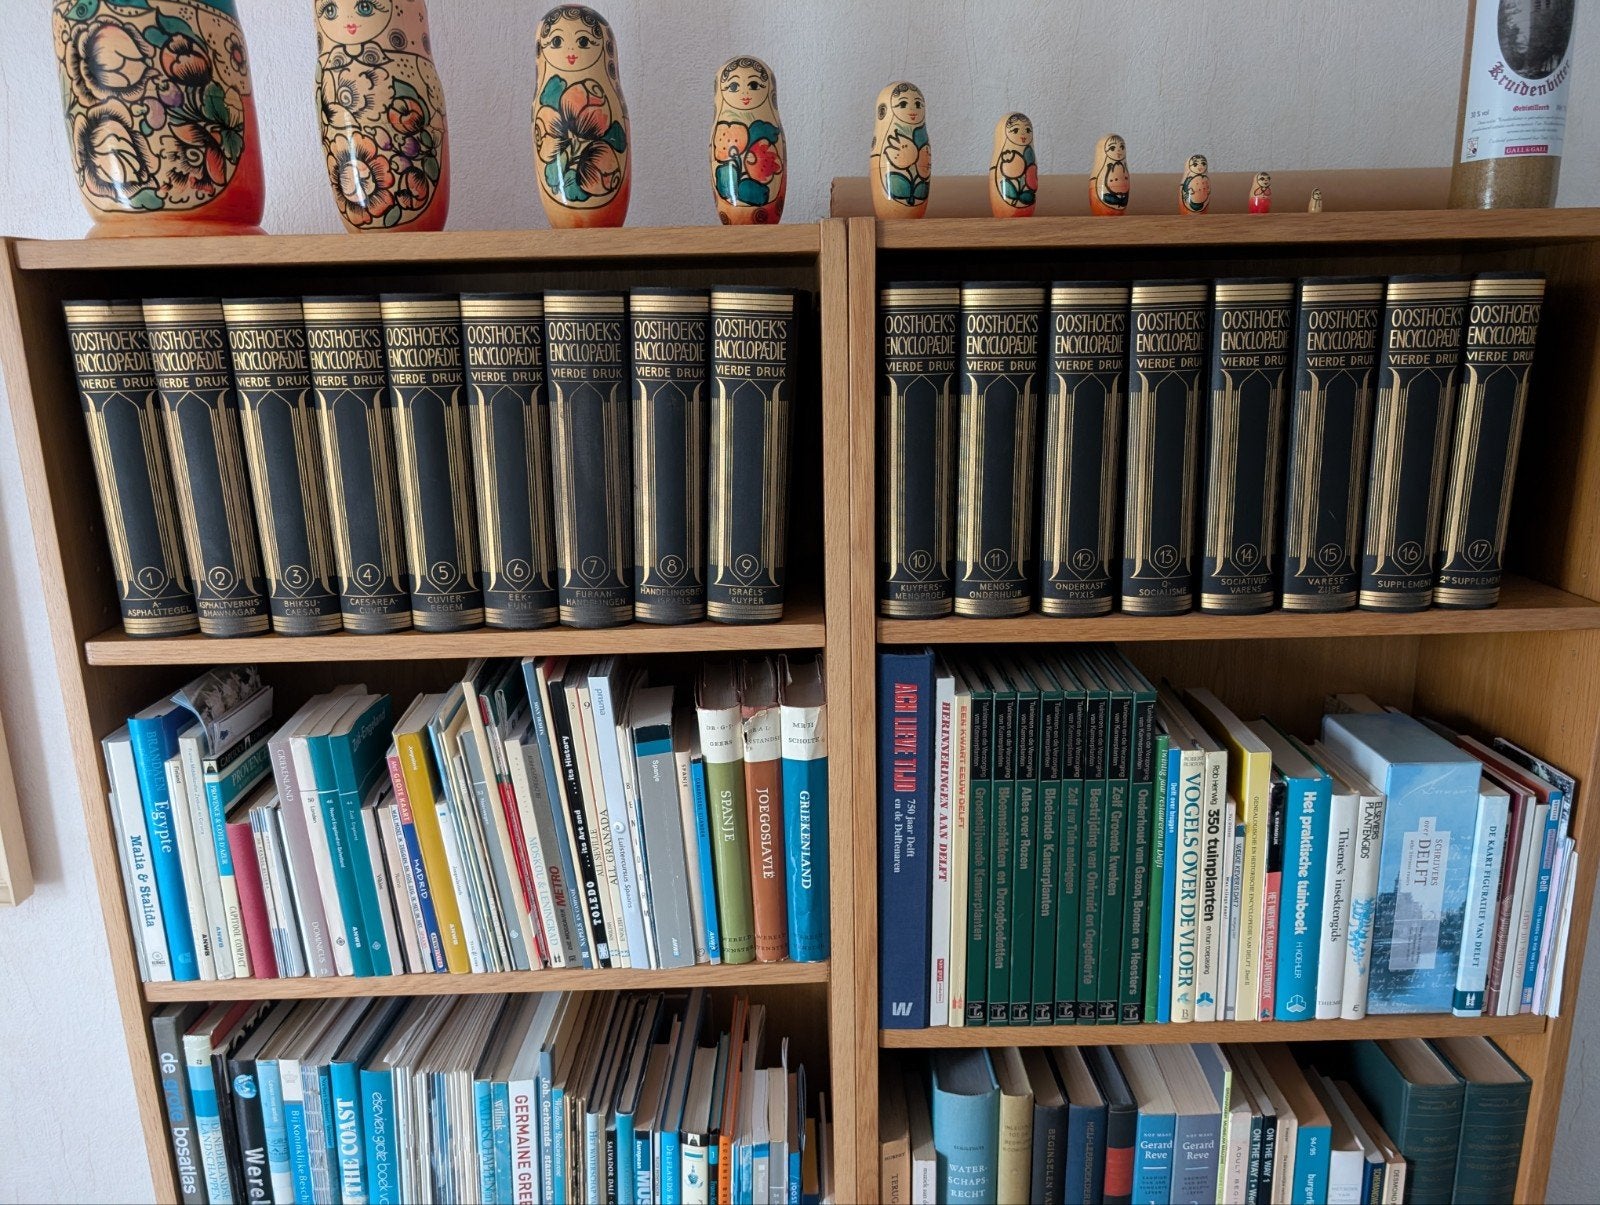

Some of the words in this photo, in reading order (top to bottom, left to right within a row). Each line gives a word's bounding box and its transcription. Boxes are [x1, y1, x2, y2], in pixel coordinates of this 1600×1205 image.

[1488, 60, 1570, 97] Kruidenbitter
[967, 314, 1038, 333] OOSTHOEK'S
[1471, 305, 1540, 323] OOSTHOEK'S
[230, 329, 304, 349] OOSTHOEK'S
[468, 325, 541, 345] OOSTHOEK'S
[715, 319, 786, 339] OOSTHOEK'S
[967, 361, 1004, 371] VIERDE
[1010, 360, 1037, 370] DRUK
[1467, 351, 1507, 361] VIERDE
[238, 377, 271, 388] VIERDE
[277, 375, 310, 386] DRUK
[472, 371, 507, 381] VIERDE
[513, 371, 543, 381] DRUK
[715, 365, 751, 375] VIERDE
[756, 367, 786, 377] DRUK
[1473, 544, 1488, 557] 17
[729, 588, 766, 596] ISRAELS-
[980, 583, 1014, 591] MENGS-
[1069, 590, 1095, 599] PYXIS
[1138, 587, 1188, 596] SOCIALISME
[286, 607, 320, 616] CAESAR
[732, 597, 764, 605] KUYPER
[595, 689, 607, 716] prisma
[894, 684, 918, 712] ACH
[894, 717, 917, 754] LIEVE
[959, 730, 967, 764] KWART
[147, 731, 164, 791] BRANDAEN
[561, 736, 573, 767] History
[938, 701, 951, 809] HERINNERINGEN
[277, 749, 293, 802] GRIEKENLAND
[894, 759, 917, 792] TIJD
[958, 766, 967, 795] EEUW
[1212, 765, 1221, 777] Rob
[394, 774, 405, 796] GROTE
[1111, 787, 1123, 808] Zelf
[1210, 780, 1220, 805] Herwig
[399, 798, 411, 821] KAART
[894, 799, 901, 808] en
[906, 799, 915, 813] 750
[1021, 787, 1032, 812] Alles
[1183, 773, 1201, 847] VOGELS
[1303, 792, 1317, 813] Het
[152, 800, 172, 853] Egypte
[574, 810, 582, 824] and
[721, 790, 735, 842] SPANJE
[894, 810, 903, 821] de
[904, 816, 915, 834] jaar
[938, 812, 949, 840] AAN
[958, 798, 966, 829] DELFT
[1021, 815, 1030, 837] over
[1043, 789, 1056, 840] Bloeiende
[1135, 789, 1148, 844] Onderhoud
[1208, 809, 1220, 834] 350
[1371, 802, 1382, 839] ELSEVIERS
[577, 826, 586, 840] Art
[599, 809, 615, 862] GRANADA
[756, 788, 775, 879] JOEGOSLAVIË
[800, 791, 812, 889] GRIEKENLAND
[1110, 811, 1122, 852] Groente
[1361, 802, 1374, 859] PLANTENGIDS
[1423, 821, 1431, 836] over
[1489, 826, 1497, 837] DE
[590, 828, 601, 860] SEVILLE
[893, 824, 903, 873] Delftenaren
[906, 836, 916, 857] Delft
[1020, 839, 1030, 869] Rozen
[1135, 847, 1145, 863] van
[1298, 816, 1315, 877] praktische
[1336, 828, 1350, 874] Thieme's
[1485, 840, 1496, 867] KAART
[607, 865, 618, 885] ALL
[618, 837, 629, 882] Luistercursus
[624, 885, 633, 909] Spaans
[938, 843, 948, 882] DELFT
[1107, 856, 1119, 896] kweken
[1180, 851, 1198, 901] OVER
[1414, 839, 1431, 886] DELFT
[1430, 839, 1443, 886] SCHRIJVERS
[131, 835, 146, 870] Malia
[140, 886, 155, 927] Stalida
[413, 859, 427, 899] MADRID
[549, 866, 564, 907] METRO
[1041, 844, 1054, 916] Kamerplanten
[1132, 866, 1145, 898] Gazon,
[1204, 837, 1220, 922] tuinplanten
[586, 881, 601, 925] TOLEDO
[1267, 892, 1276, 904] HET
[1294, 881, 1309, 935] tuinboek
[1478, 870, 1492, 919] FIGURATIEF
[229, 906, 240, 937] CAPITOOL
[1132, 901, 1143, 934] Bomen
[1180, 904, 1195, 927] DE
[1265, 905, 1275, 928] NIEUWE
[1330, 879, 1345, 942] insektengids
[312, 921, 325, 964] DOMINICUS
[1132, 938, 1140, 948] en
[1476, 923, 1485, 939] VAN
[202, 934, 210, 956] ANWB
[234, 938, 246, 967] COMPACT
[1178, 929, 1195, 987] VLOER
[1472, 942, 1483, 967] DELFT
[1129, 953, 1141, 995] Heesters
[1262, 929, 1275, 999] KAMERPLANTENBOEK
[161, 1052, 178, 1074] de
[163, 1078, 185, 1121] grote
[541, 1078, 550, 1097] Joh.
[291, 1110, 301, 1123] Bij
[337, 1098, 357, 1154] COAST
[371, 1092, 387, 1134] elseviers
[494, 1100, 506, 1130] Willink
[542, 1101, 552, 1146] Gerbrands
[479, 1094, 496, 1191] WATERSCHAPPEN
[515, 1095, 531, 1169] GERMAINE
[1140, 1140, 1172, 1150] Gerard
[1182, 1140, 1214, 1150] Gerard
[1265, 1128, 1274, 1140] ON
[293, 1125, 306, 1173] Koninklijke
[374, 1136, 387, 1161] grote
[607, 1141, 615, 1176] SALVADOR
[1145, 1151, 1167, 1160] Reve
[1187, 1151, 1209, 1160] Reve
[1264, 1142, 1273, 1158] THE
[1309, 1137, 1317, 1156] 94/95
[173, 1128, 198, 1194] bosatlas
[949, 1164, 988, 1173] WATER-
[1263, 1159, 1272, 1177] WAY
[343, 1159, 362, 1196] THE
[377, 1163, 392, 1190] boek
[948, 1177, 988, 1185] SCHAPS-
[951, 1189, 986, 1198] RECHT
